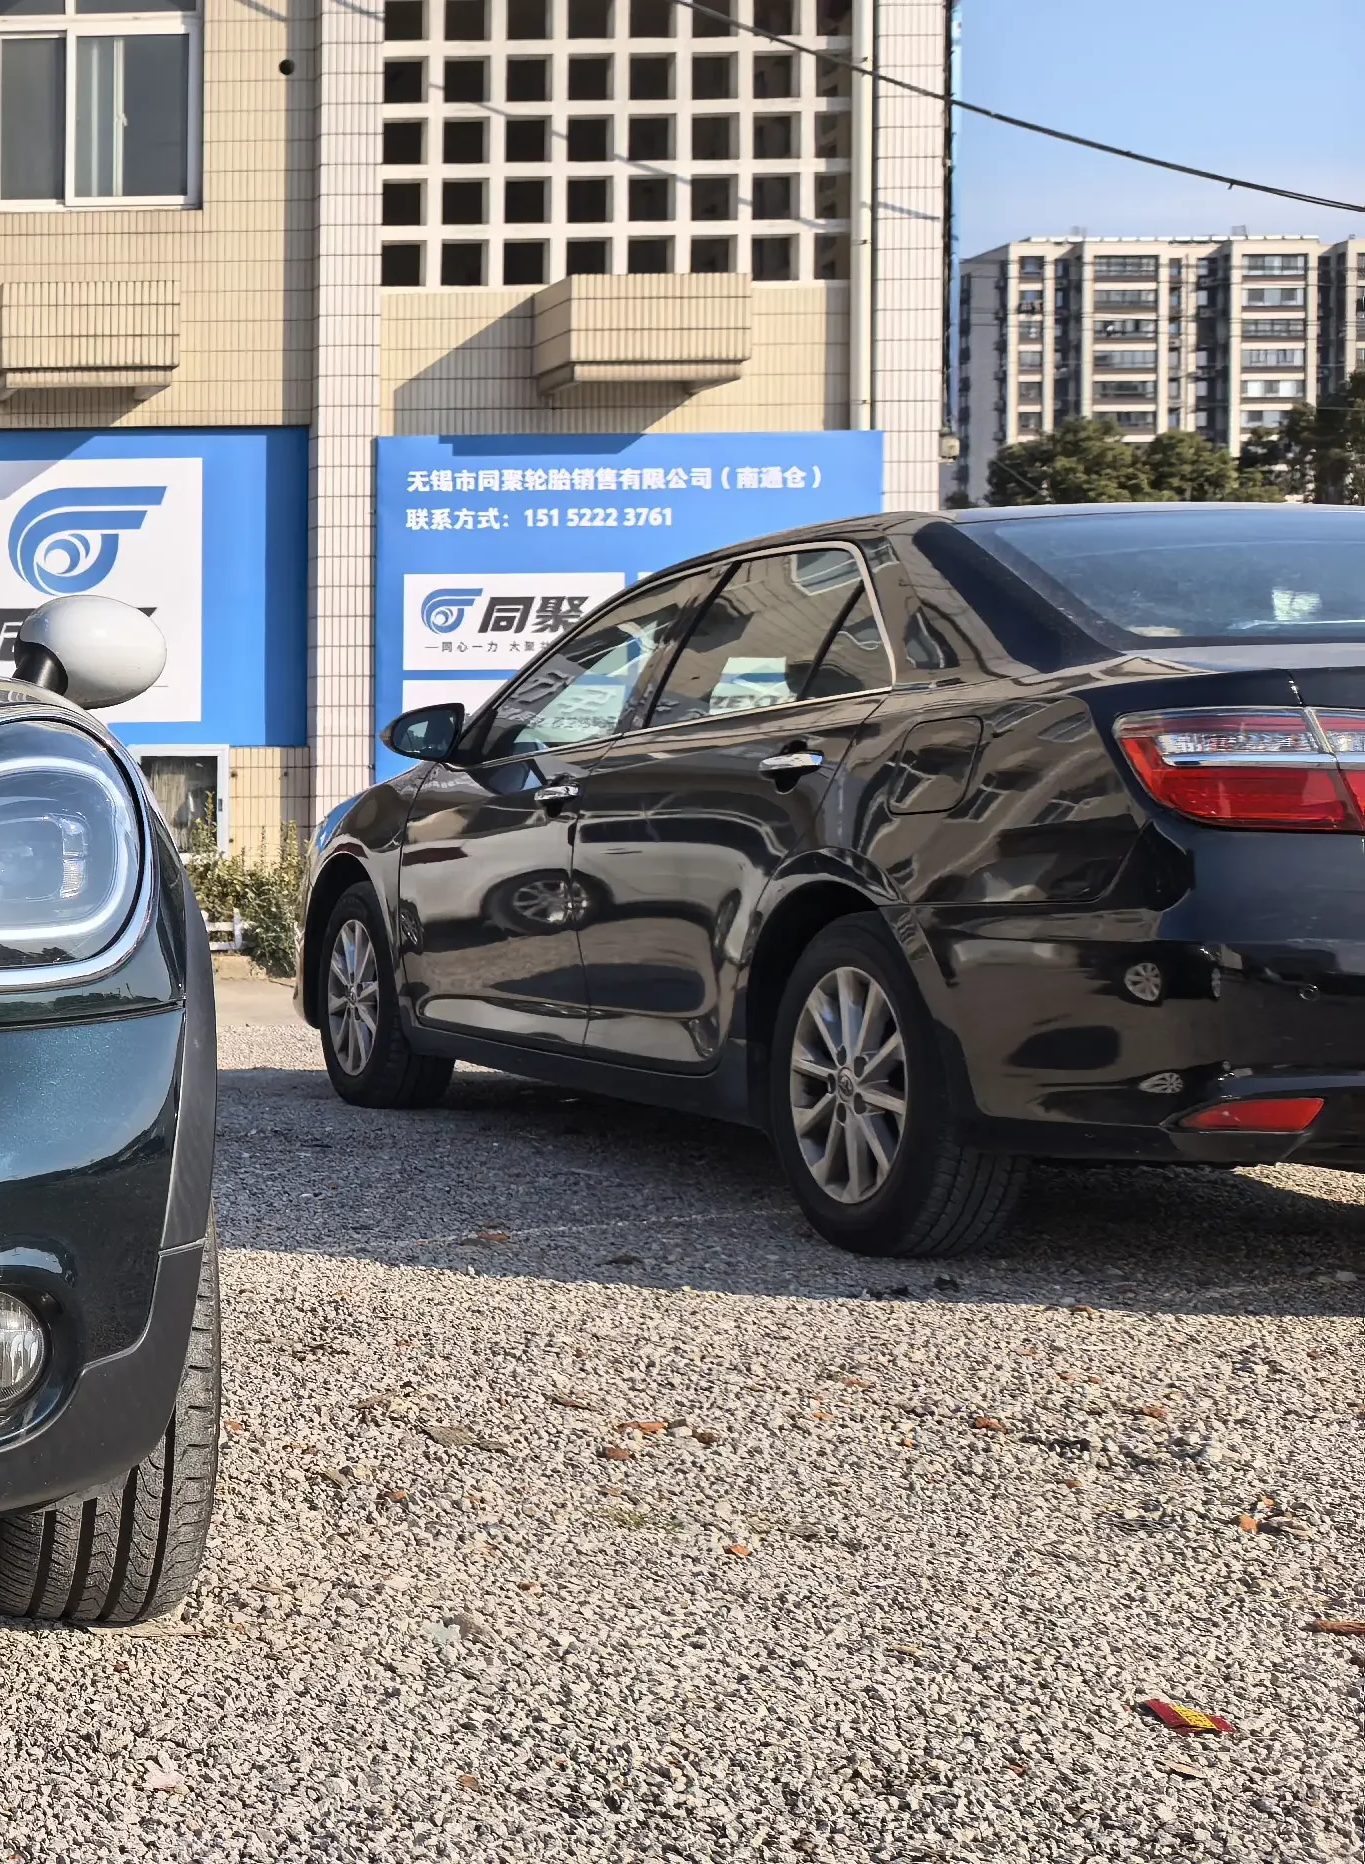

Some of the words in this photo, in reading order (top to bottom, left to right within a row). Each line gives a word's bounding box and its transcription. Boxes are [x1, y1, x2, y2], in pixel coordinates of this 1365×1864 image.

[405, 508, 509, 531] 联系方式：
[524, 508, 559, 528] 151
[566, 508, 617, 527] 5222
[623, 507, 673, 527] 3761
[477, 596, 589, 634] 同聚
